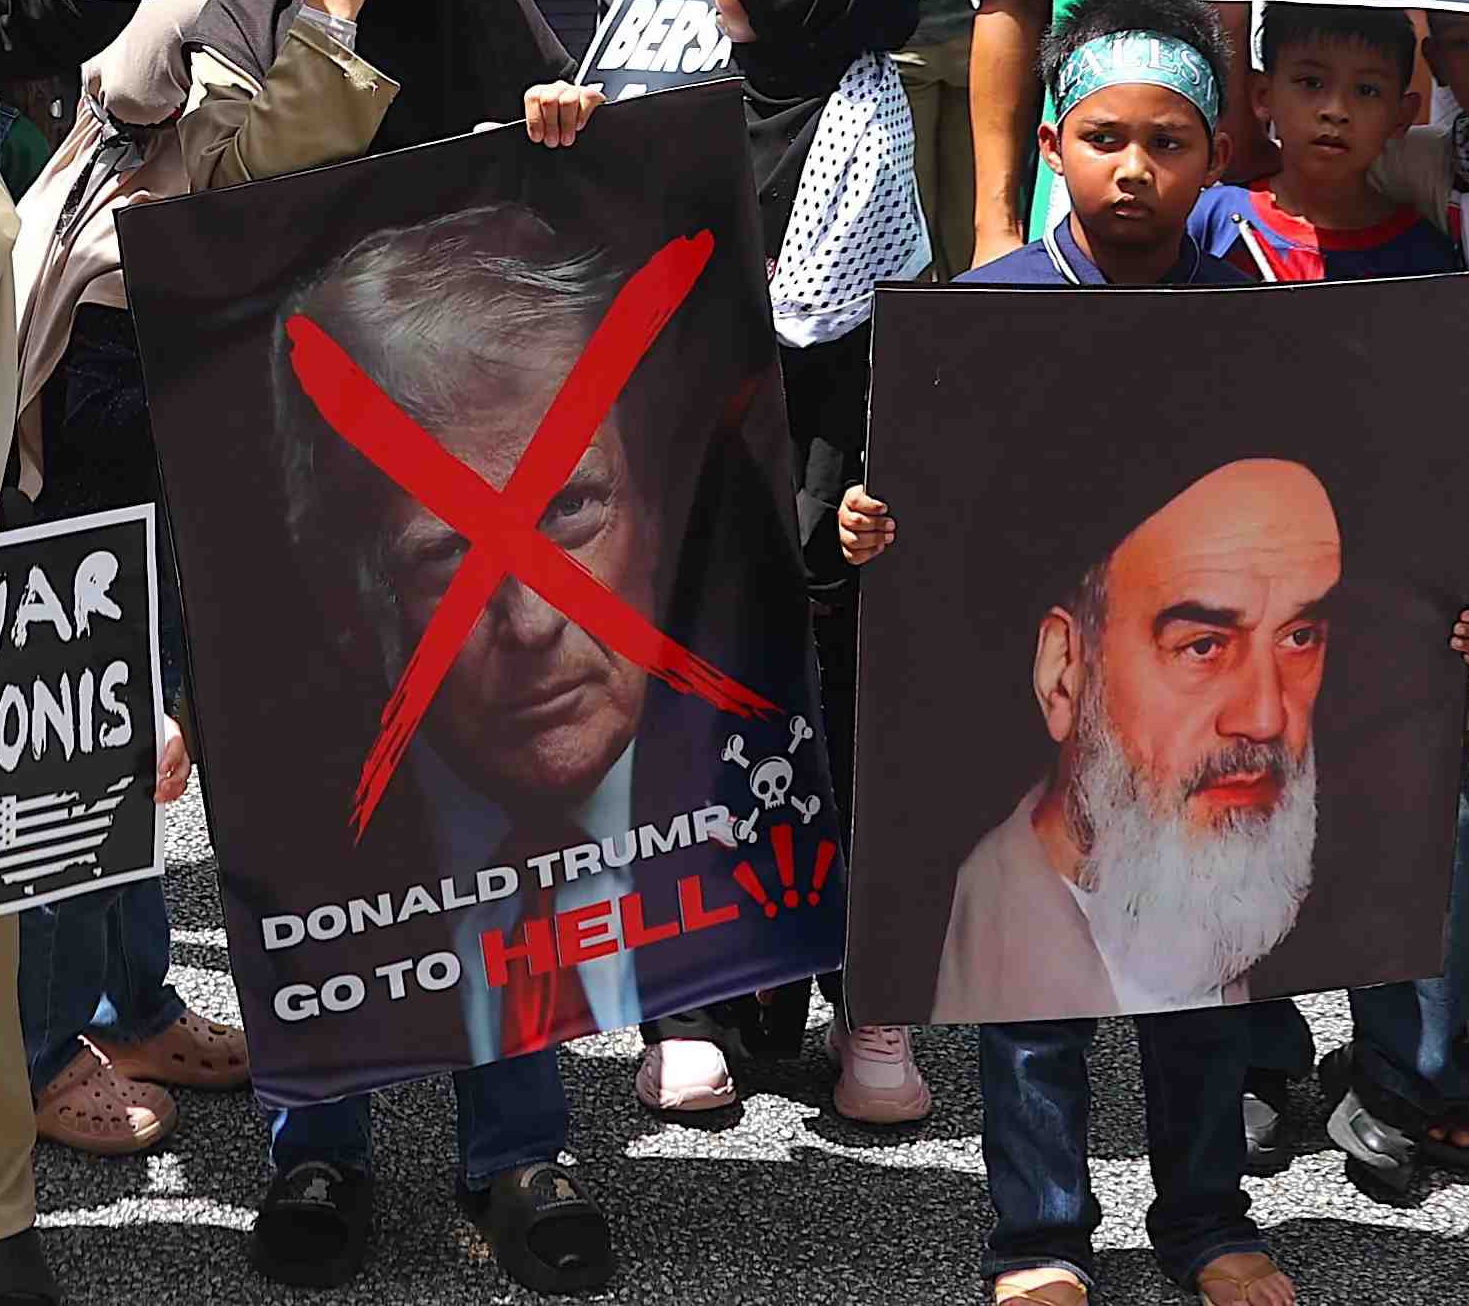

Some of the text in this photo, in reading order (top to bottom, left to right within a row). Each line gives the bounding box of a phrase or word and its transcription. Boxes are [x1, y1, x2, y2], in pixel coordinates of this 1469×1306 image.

[1059, 38, 1215, 101] PALES
[262, 804, 736, 951] DONALD TRUMP
[272, 975, 366, 1022] GO
[376, 950, 461, 1000] TO
